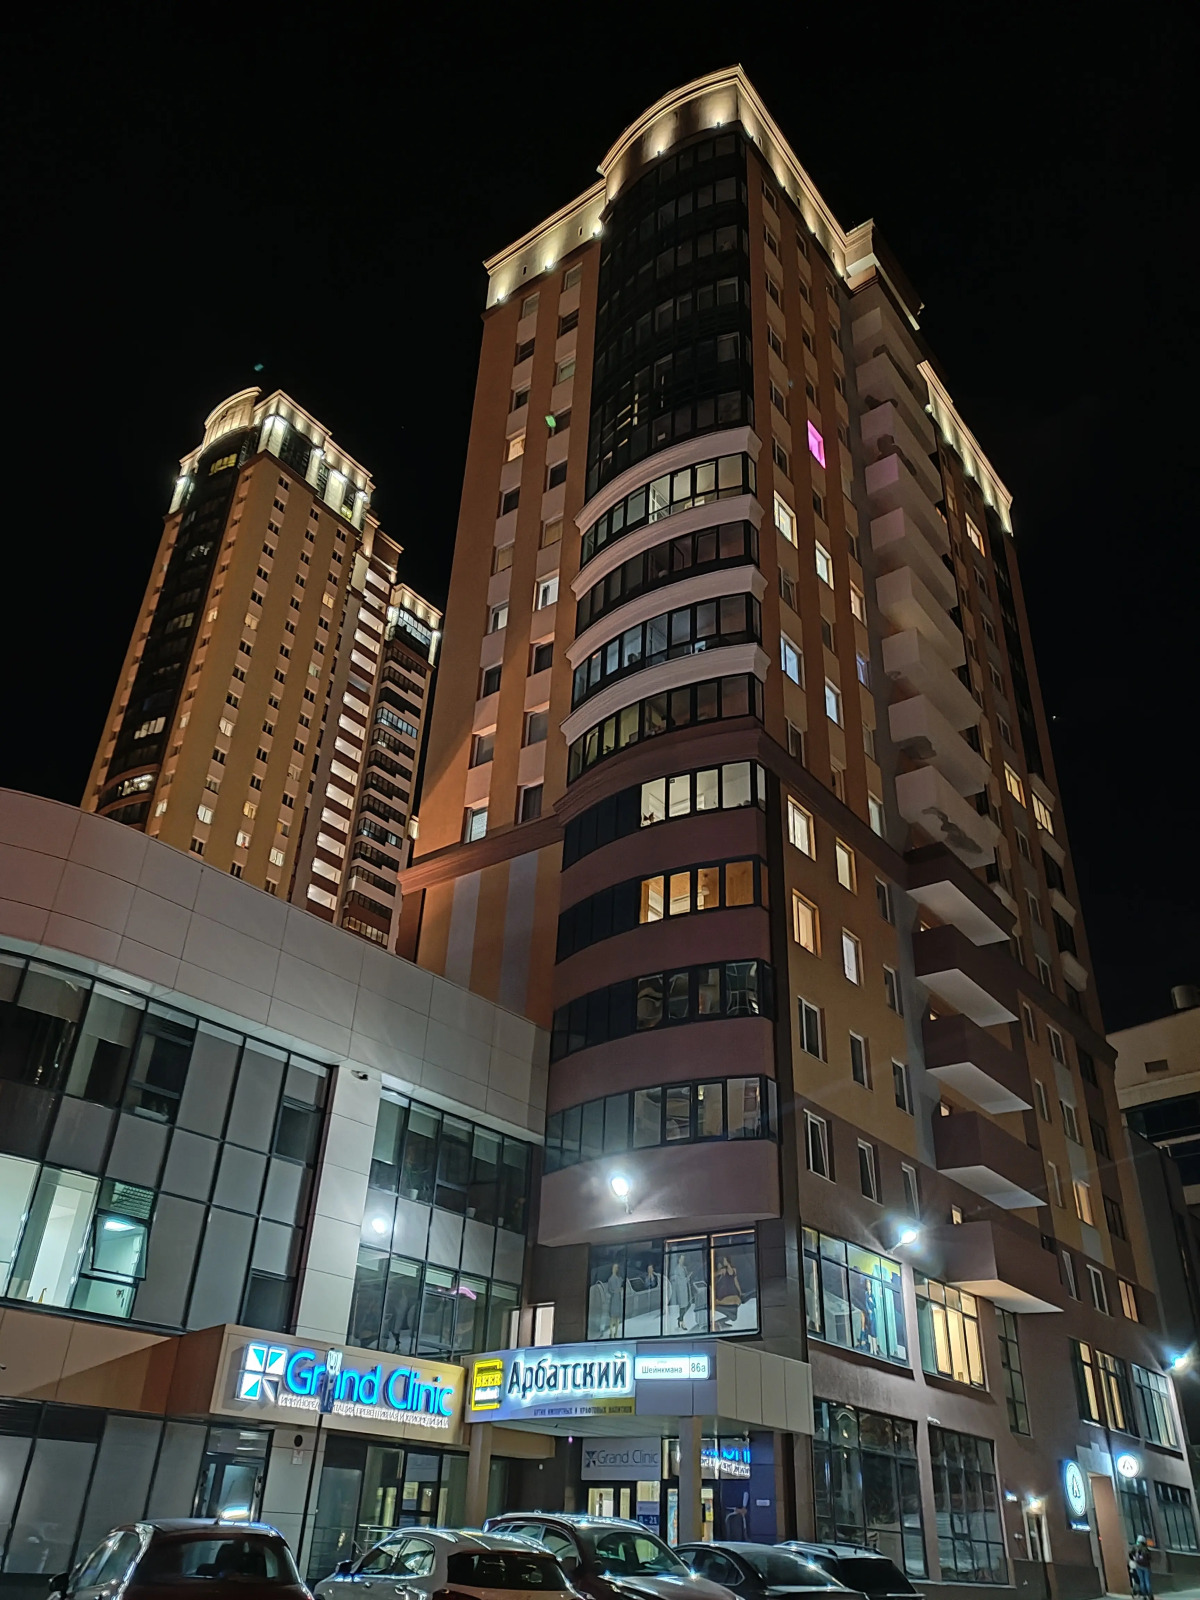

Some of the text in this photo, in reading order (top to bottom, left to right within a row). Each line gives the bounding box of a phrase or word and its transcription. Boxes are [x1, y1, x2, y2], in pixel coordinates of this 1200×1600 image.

[507, 1351, 627, 1399] Арбатский
[641, 1362, 706, 1374] Шейнкмана 86а
[475, 1373, 502, 1388] BEER
[387, 1368, 453, 1417] Clinic
[597, 1449, 659, 1464] Grand Clinic
[649, 1515, 658, 1525] 21
